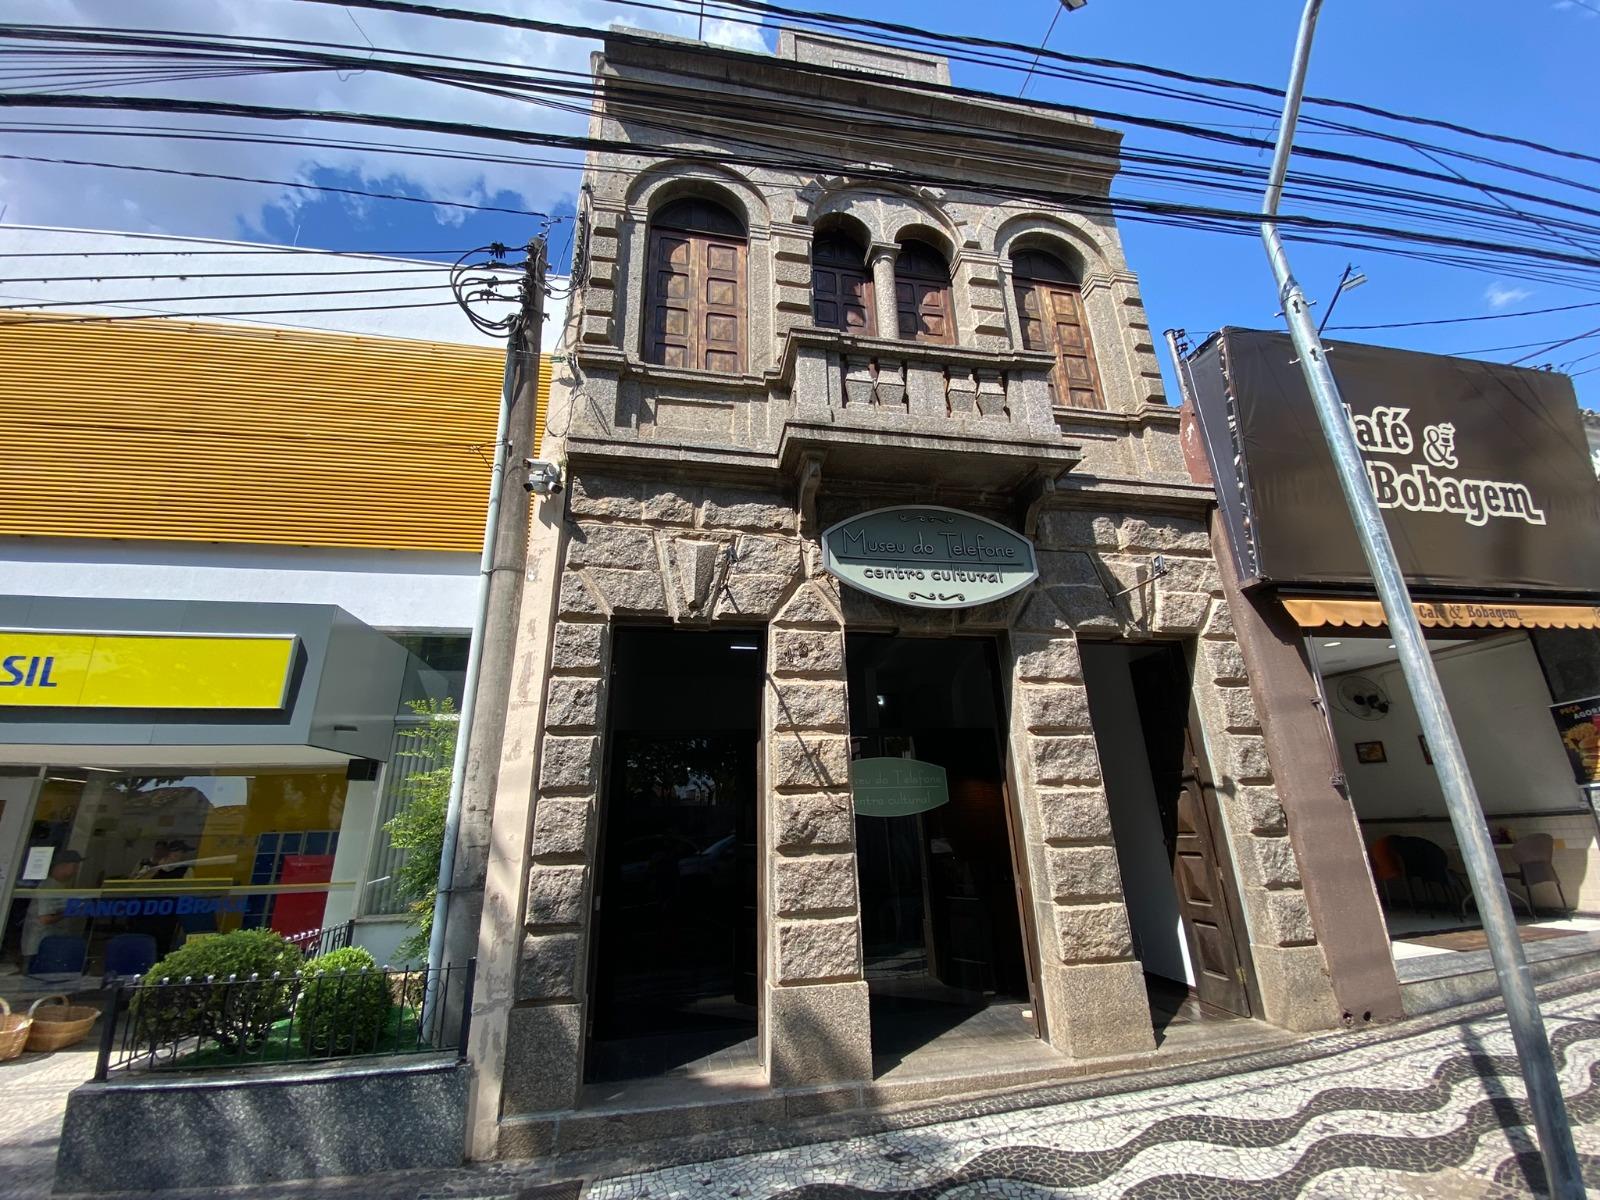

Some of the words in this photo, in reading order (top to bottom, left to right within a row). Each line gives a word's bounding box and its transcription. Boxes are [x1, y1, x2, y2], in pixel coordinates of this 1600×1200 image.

[1341, 403, 1414, 455] afé
[1422, 422, 1459, 470] &
[1366, 460, 1547, 527] Bobagem
[842, 528, 905, 556] Museu
[912, 531, 935, 555] do
[939, 532, 1015, 562] Telefone
[863, 565, 926, 580] centro
[930, 565, 1004, 584] cultural
[1449, 605, 1463, 620] &
[1466, 605, 1522, 621] Bobagem
[144, 899, 173, 915] DO
